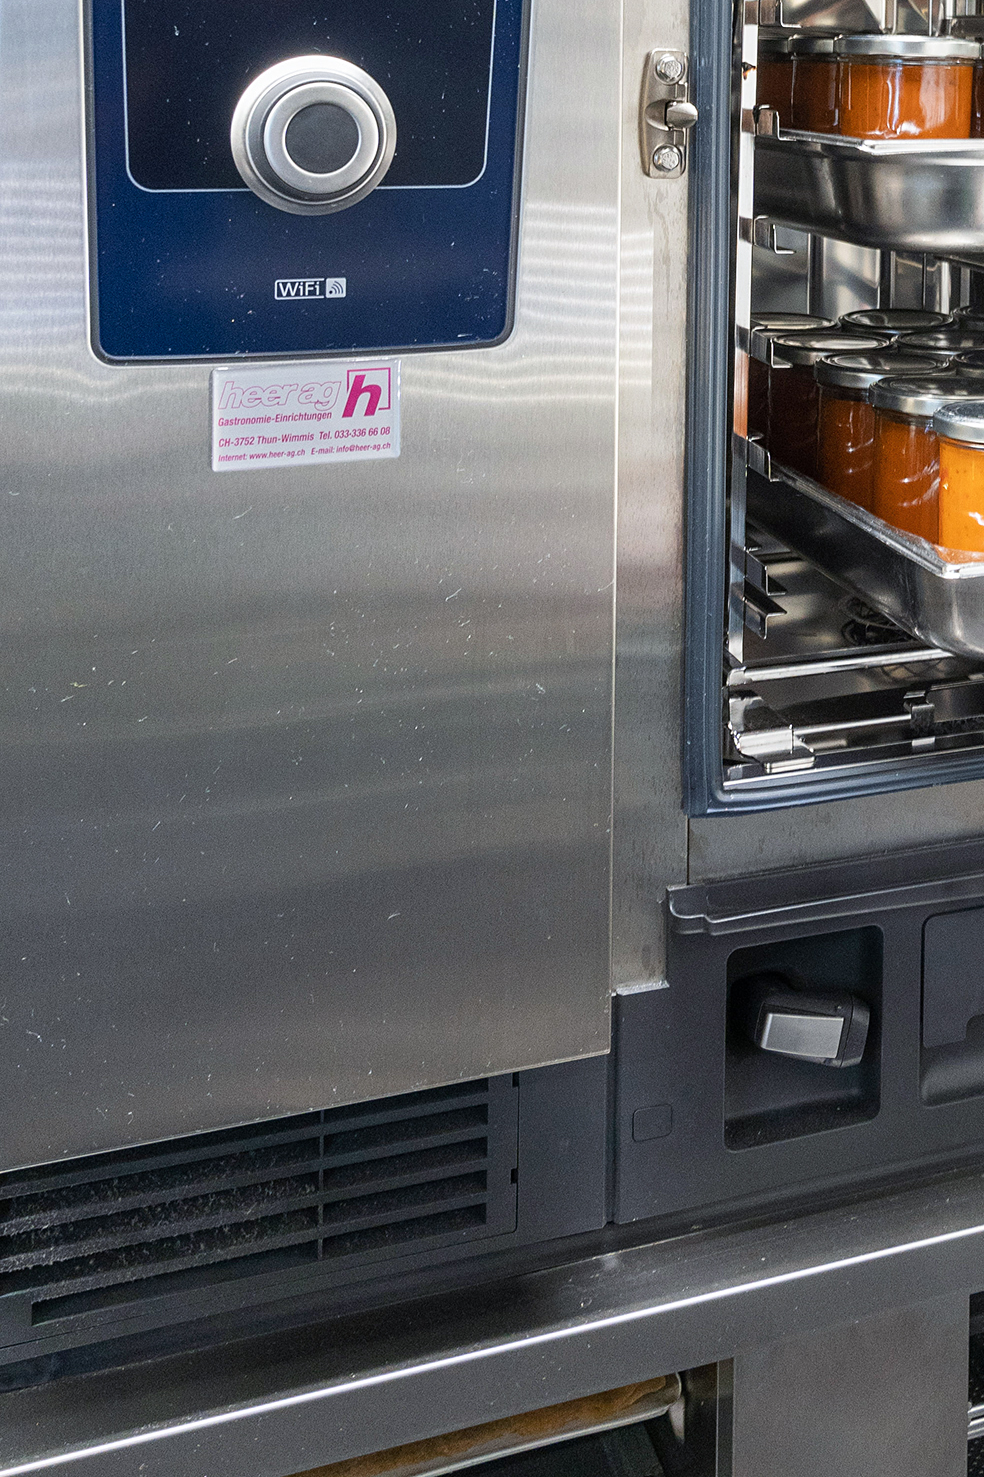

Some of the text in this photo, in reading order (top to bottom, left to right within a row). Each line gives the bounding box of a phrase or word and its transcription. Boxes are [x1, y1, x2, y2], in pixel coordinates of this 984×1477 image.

[278, 281, 320, 297] WiFi
[217, 380, 342, 412] heer ag
[341, 374, 382, 418] h
[218, 412, 332, 427] Gastronomie-Einrichtungen
[218, 437, 255, 448] CH-3752
[257, 433, 315, 445] Thun-Wimmis
[319, 430, 333, 441] Tel.
[368, 427, 379, 436] 66
[380, 426, 391, 436] 08
[218, 441, 391, 463] Internet: www.heer-ag.ch E-mail: info@heer-ag.ch
